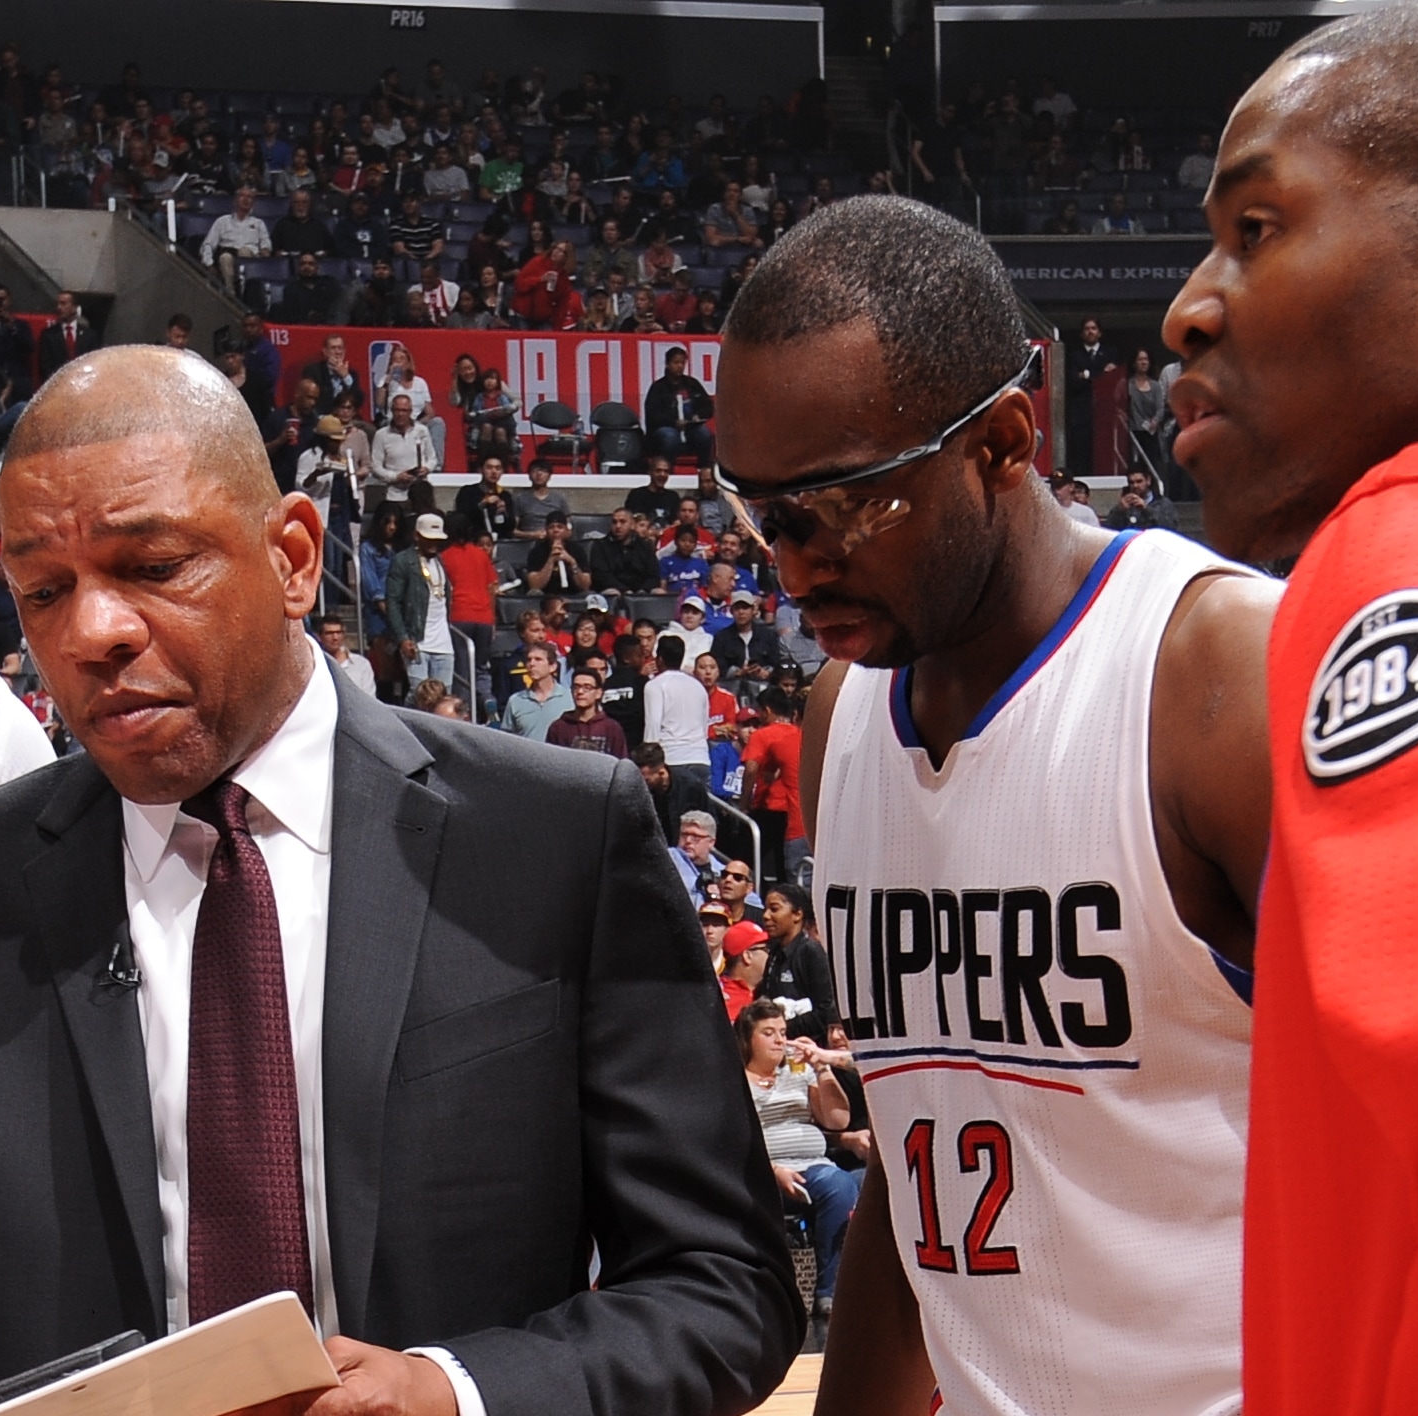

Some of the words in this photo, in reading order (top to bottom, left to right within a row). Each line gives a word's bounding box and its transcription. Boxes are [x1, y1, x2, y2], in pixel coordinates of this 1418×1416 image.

[390, 10, 425, 27] PR16
[1247, 21, 1282, 38] PR17
[1008, 267, 1104, 280] MERICAN
[1110, 267, 1191, 280] EXPRES
[270, 329, 289, 345] 113
[507, 339, 558, 435] LA
[903, 1118, 1021, 1277] 12
